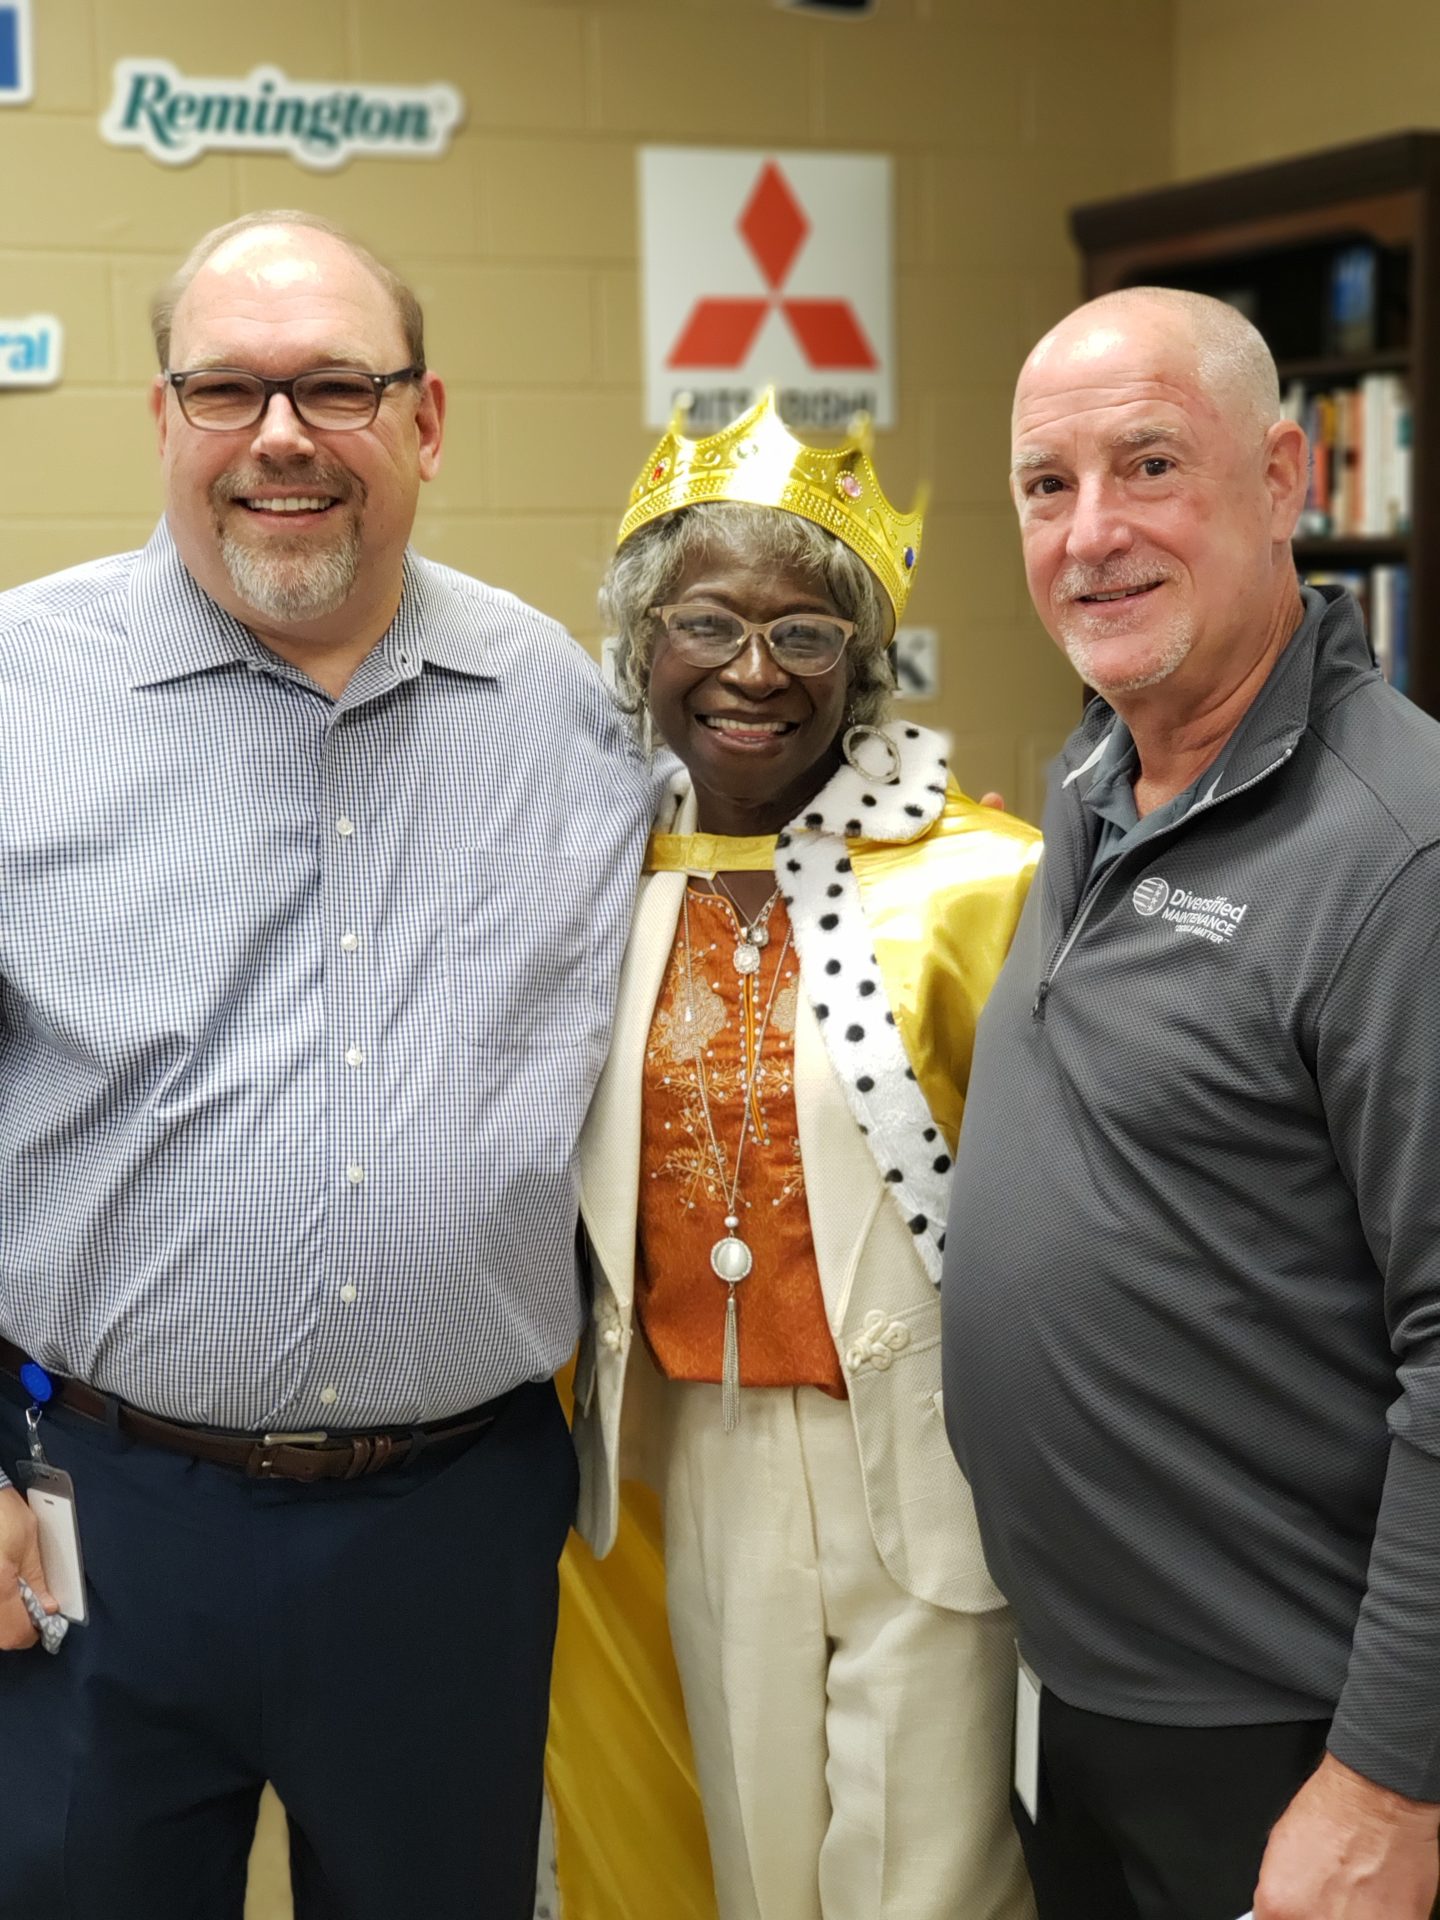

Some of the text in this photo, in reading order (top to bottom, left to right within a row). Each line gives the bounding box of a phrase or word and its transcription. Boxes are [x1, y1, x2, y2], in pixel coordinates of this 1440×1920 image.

[121, 73, 431, 147] Remington
[1162, 907, 1237, 936] MAINTENANCE
[1169, 889, 1247, 922] Diversified
